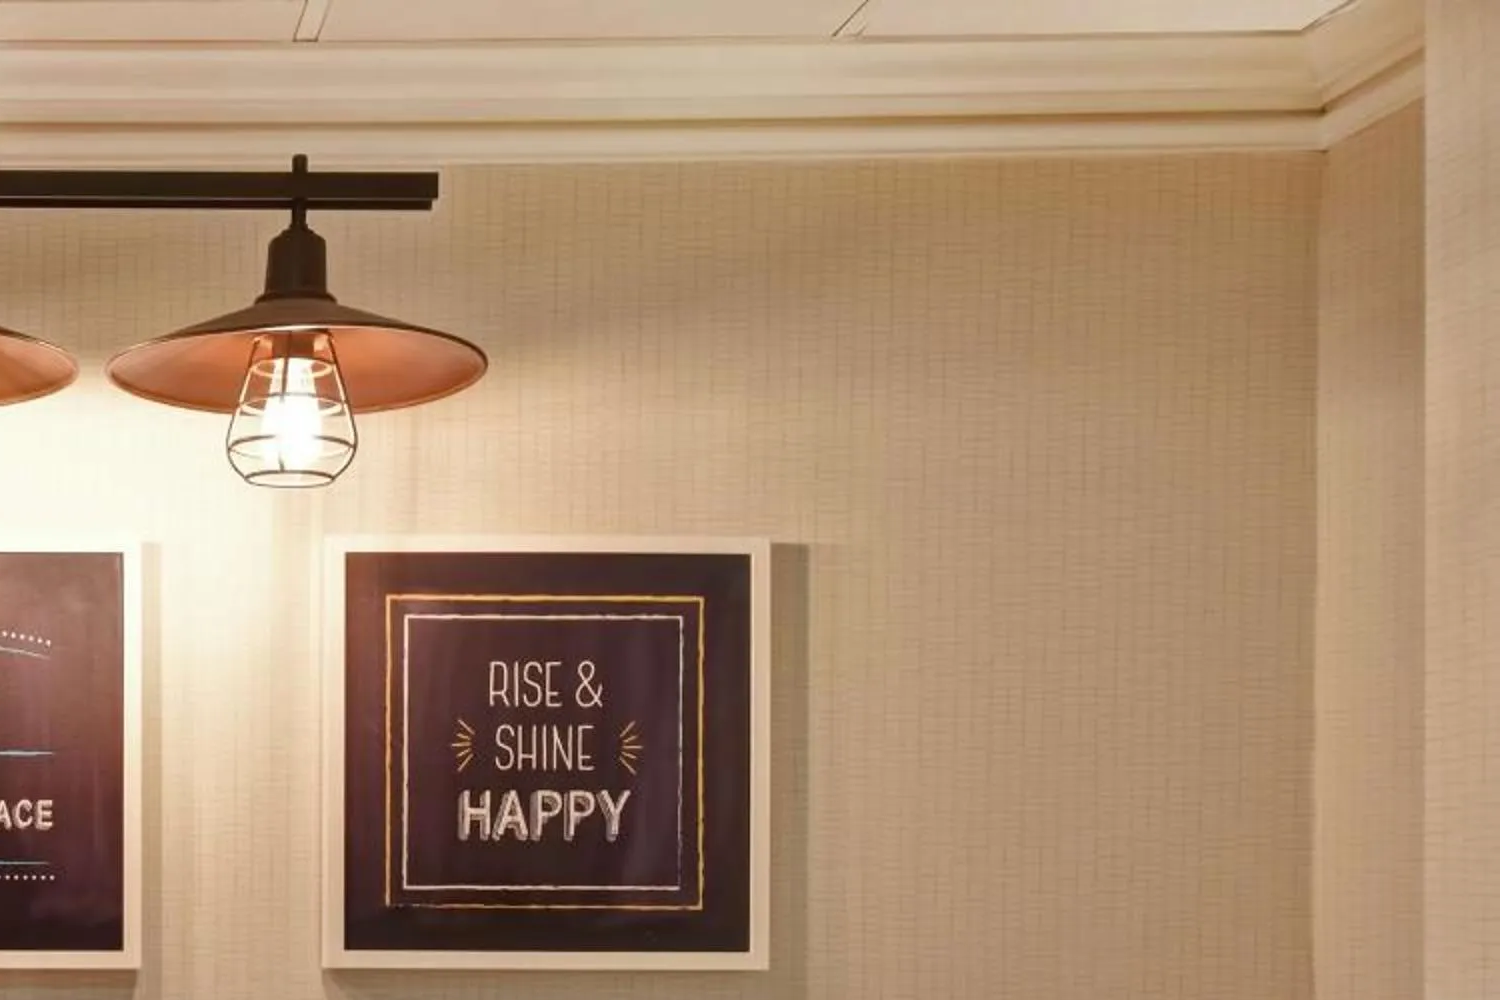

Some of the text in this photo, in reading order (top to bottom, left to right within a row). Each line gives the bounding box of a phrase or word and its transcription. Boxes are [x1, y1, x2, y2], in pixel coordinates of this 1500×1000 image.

[488, 661, 603, 707] RISE &
[494, 724, 595, 771] SHINE
[458, 789, 631, 841] HAPPY
